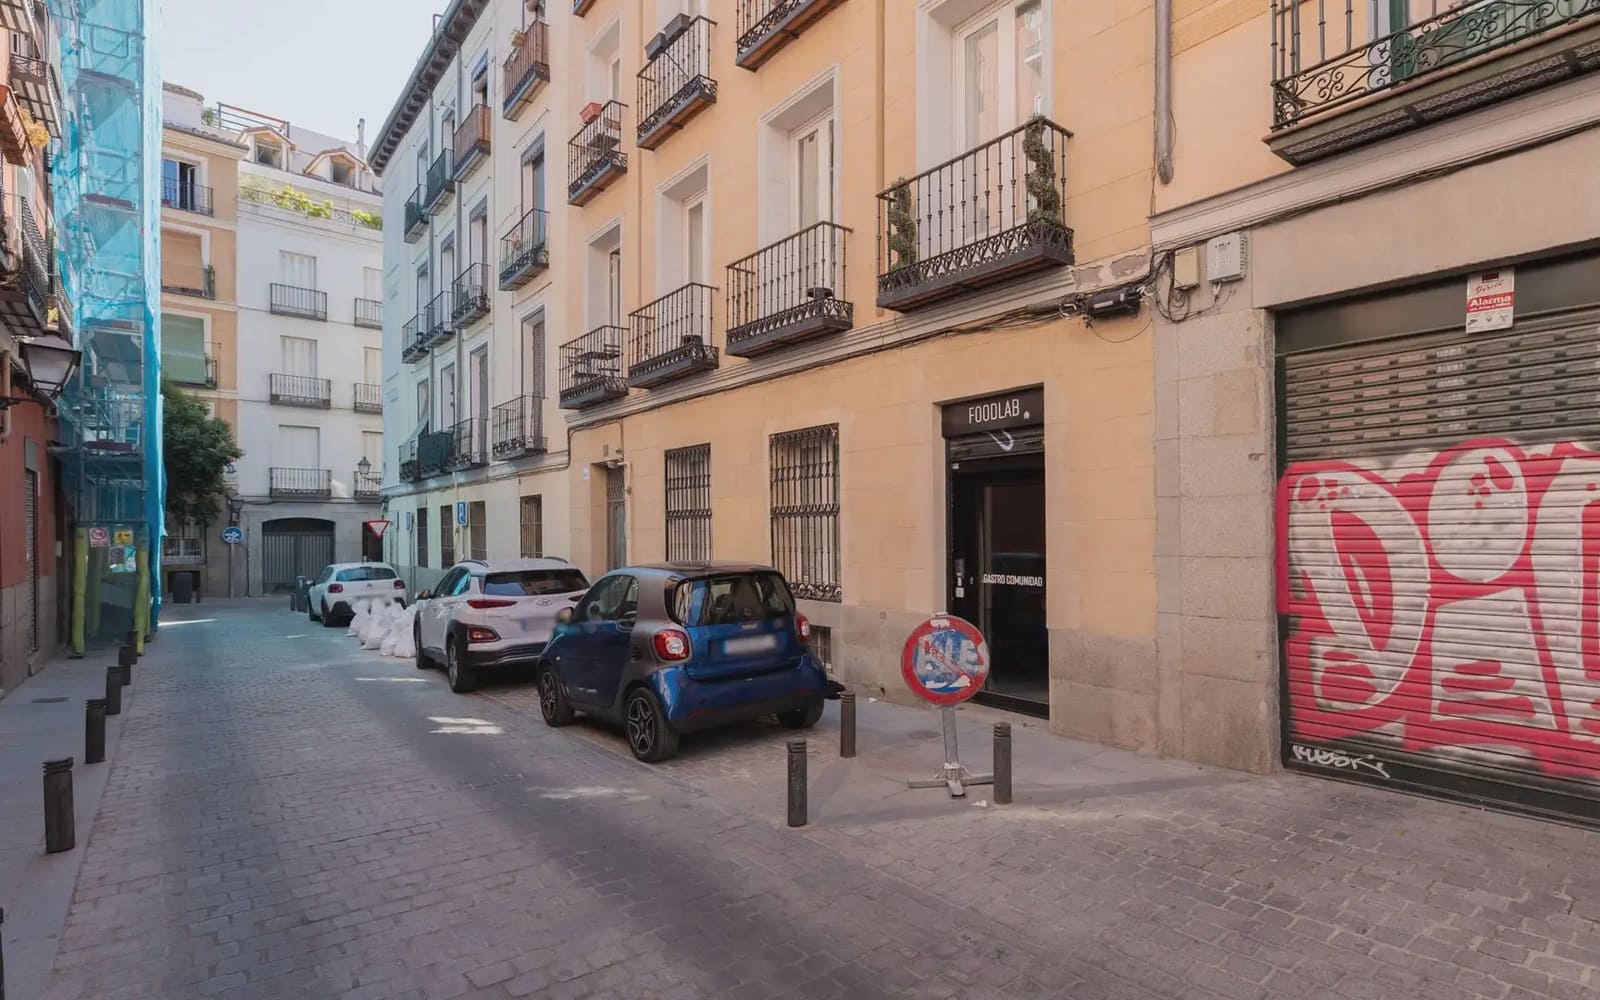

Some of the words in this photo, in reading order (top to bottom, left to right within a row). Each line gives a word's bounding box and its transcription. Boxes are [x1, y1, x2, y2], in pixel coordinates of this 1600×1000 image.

[1470, 295, 1512, 308] Alarma
[968, 398, 1020, 425] FOODLAB
[983, 573, 1006, 585] GASTRO
[1006, 575, 1043, 587] COMUNIDAD
